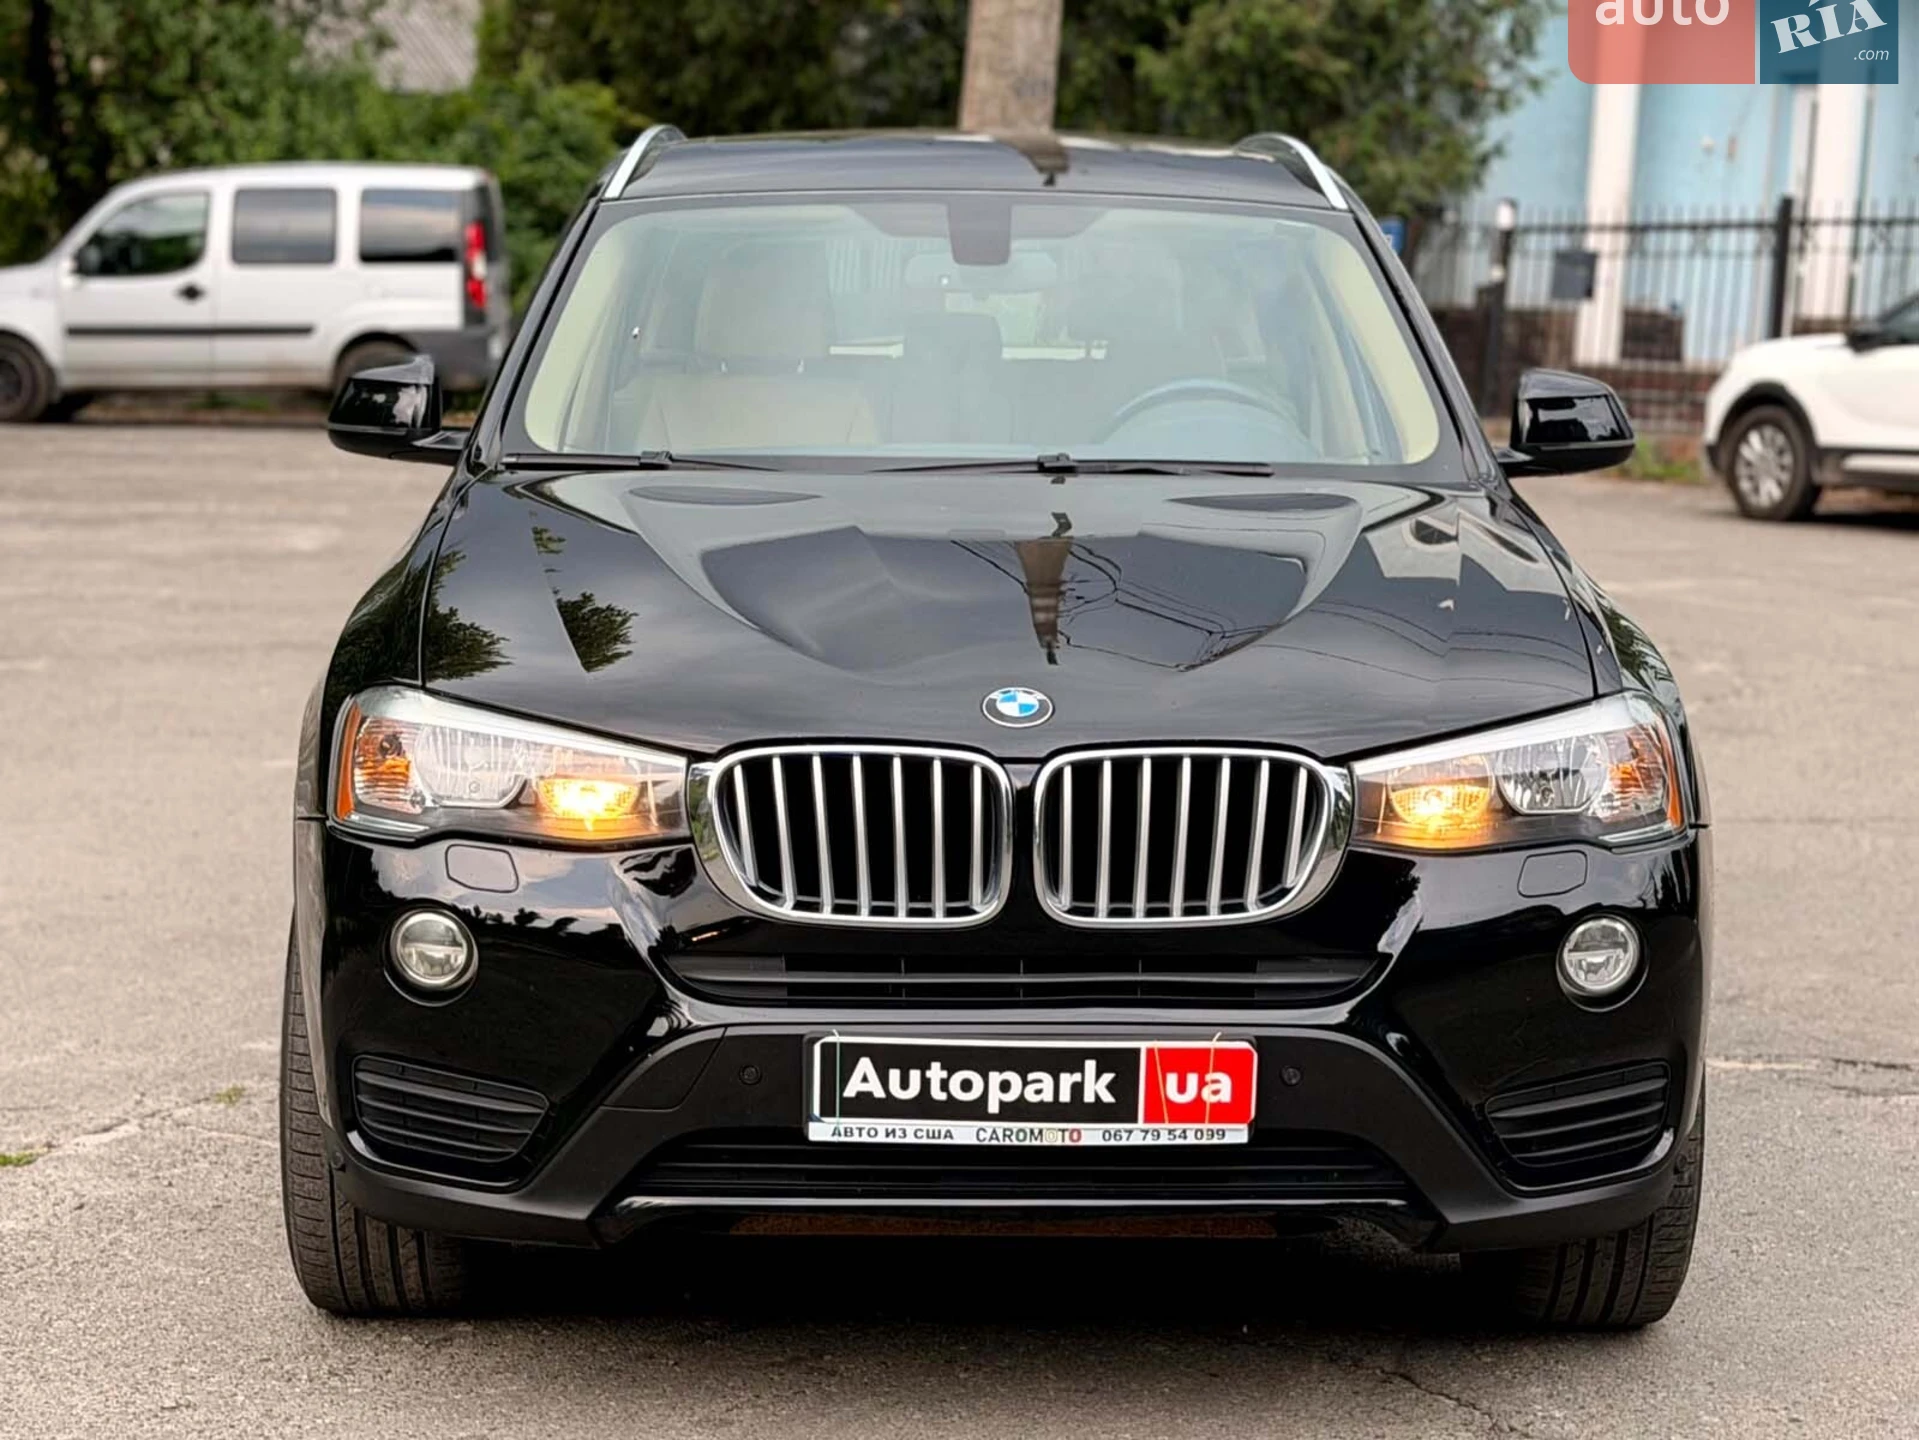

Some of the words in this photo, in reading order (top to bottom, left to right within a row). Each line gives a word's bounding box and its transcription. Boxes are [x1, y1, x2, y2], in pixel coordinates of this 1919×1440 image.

[842, 1056, 1117, 1114] Autopark
[1164, 1071, 1233, 1104] ua
[830, 1126, 879, 1139] АВТО
[884, 1127, 908, 1139] ИЗ
[913, 1128, 955, 1140] США
[975, 1127, 1083, 1143] CAROMOTO
[1101, 1128, 1134, 1142] 067
[1140, 1129, 1162, 1141] 79
[1166, 1128, 1189, 1141] 54
[1193, 1127, 1227, 1141] 099
